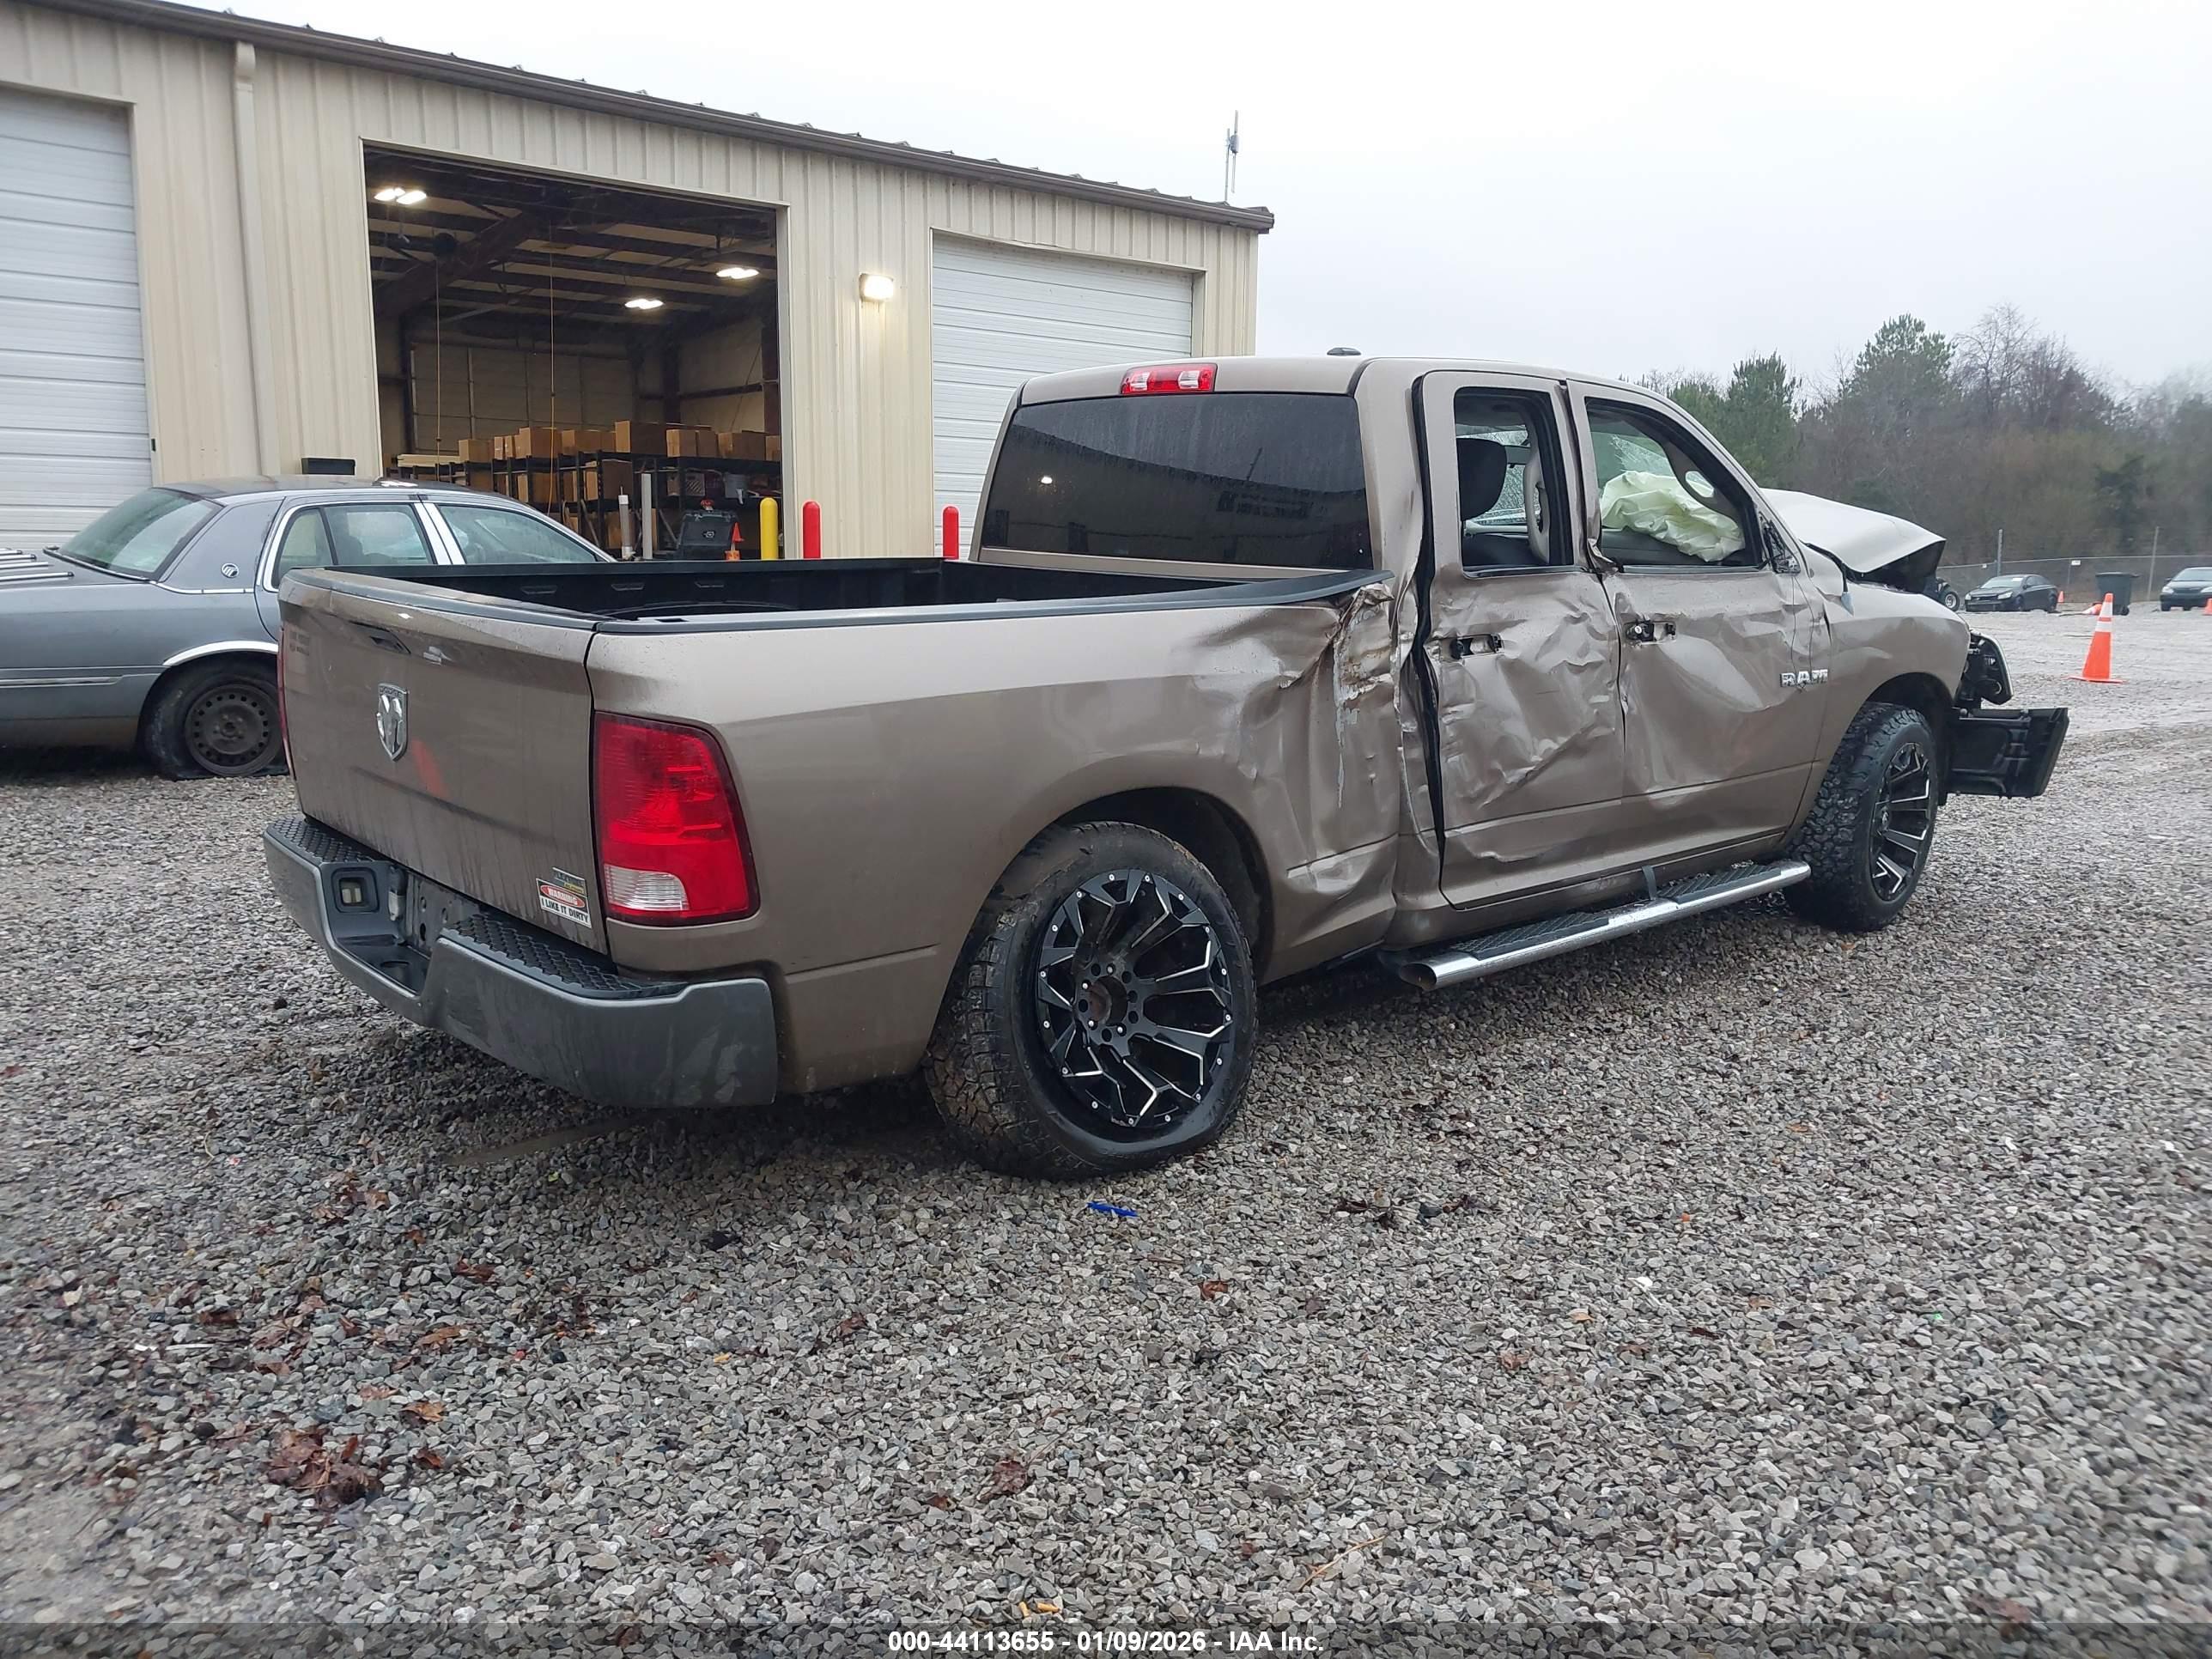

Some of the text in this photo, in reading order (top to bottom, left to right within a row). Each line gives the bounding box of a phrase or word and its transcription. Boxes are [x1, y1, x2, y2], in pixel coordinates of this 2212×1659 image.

[1781, 669, 1828, 687] RAM
[549, 888, 578, 906] WARNING
[545, 899, 559, 911] LIKE
[561, 905, 567, 915] IT
[568, 908, 588, 923] DIRTY
